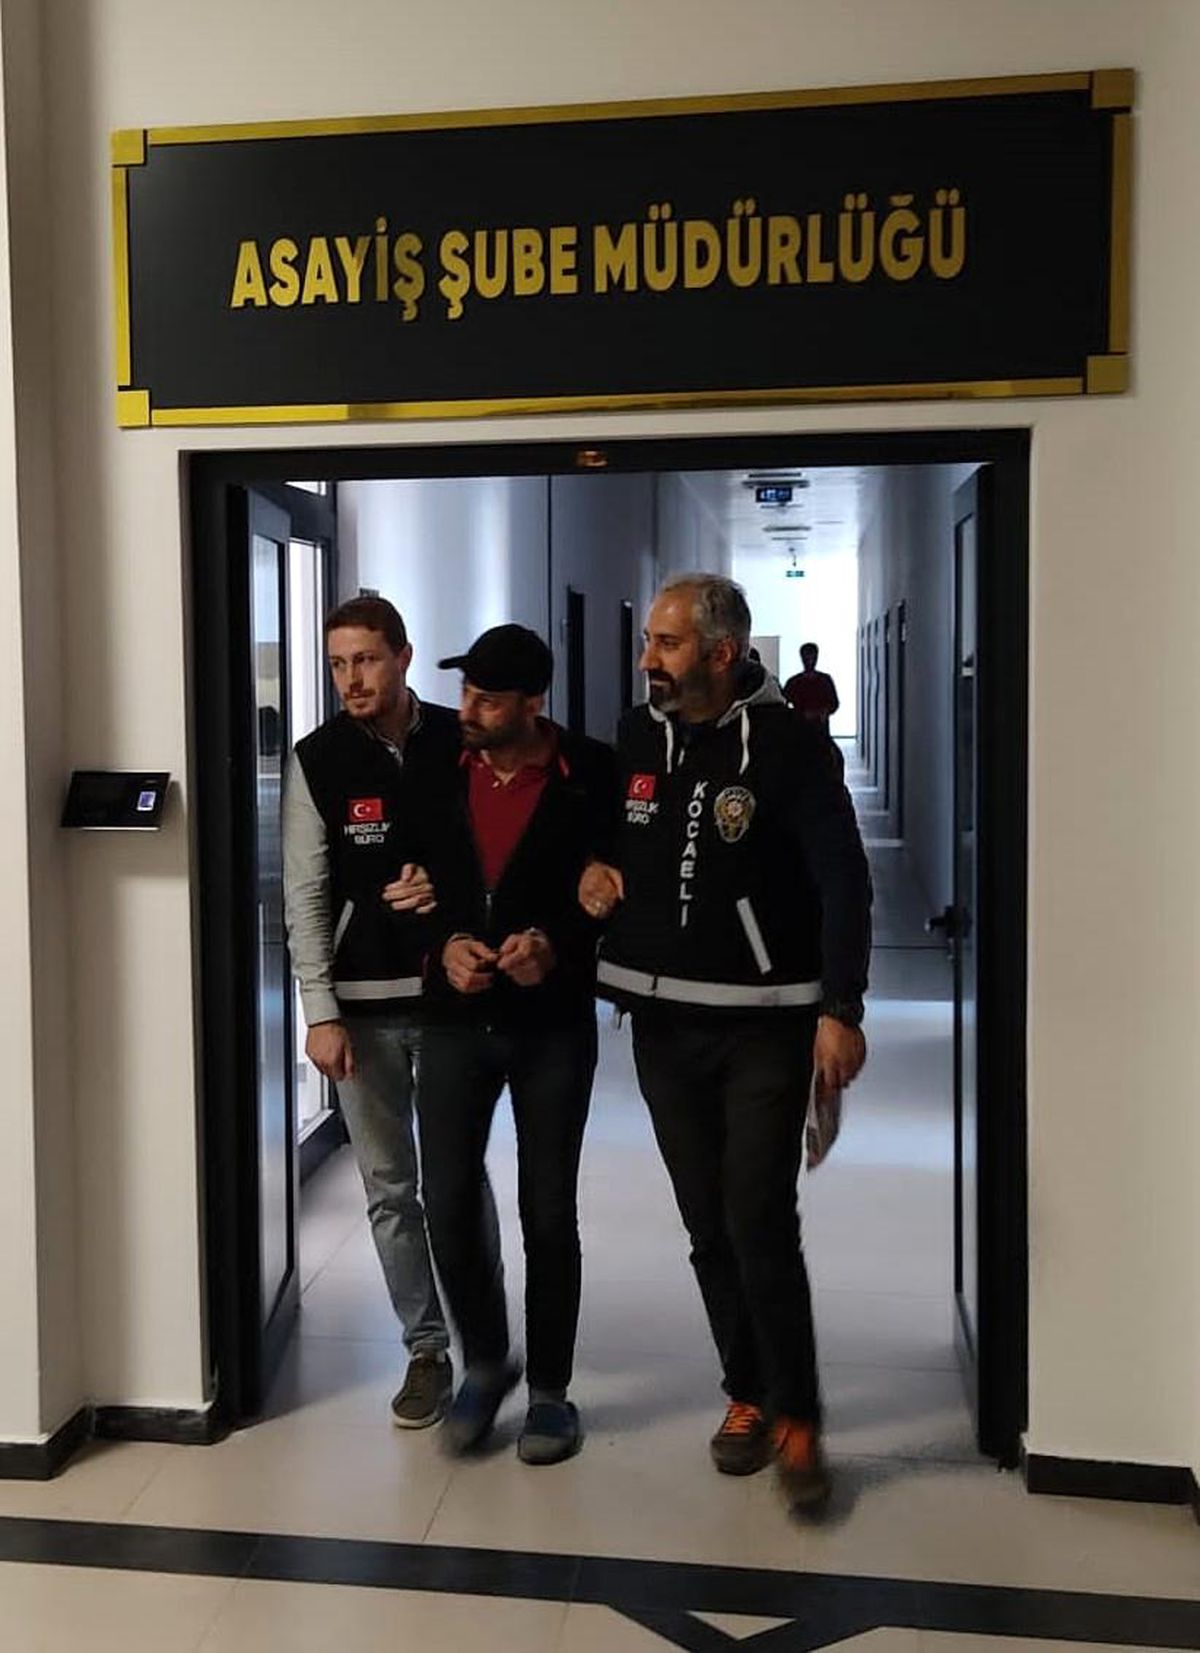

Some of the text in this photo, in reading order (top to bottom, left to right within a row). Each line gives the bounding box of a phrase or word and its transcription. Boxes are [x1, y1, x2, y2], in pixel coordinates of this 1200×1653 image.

[230, 188, 966, 321] ASAYİŞ ŞUBE MÜDÜRLÜĞÜ
